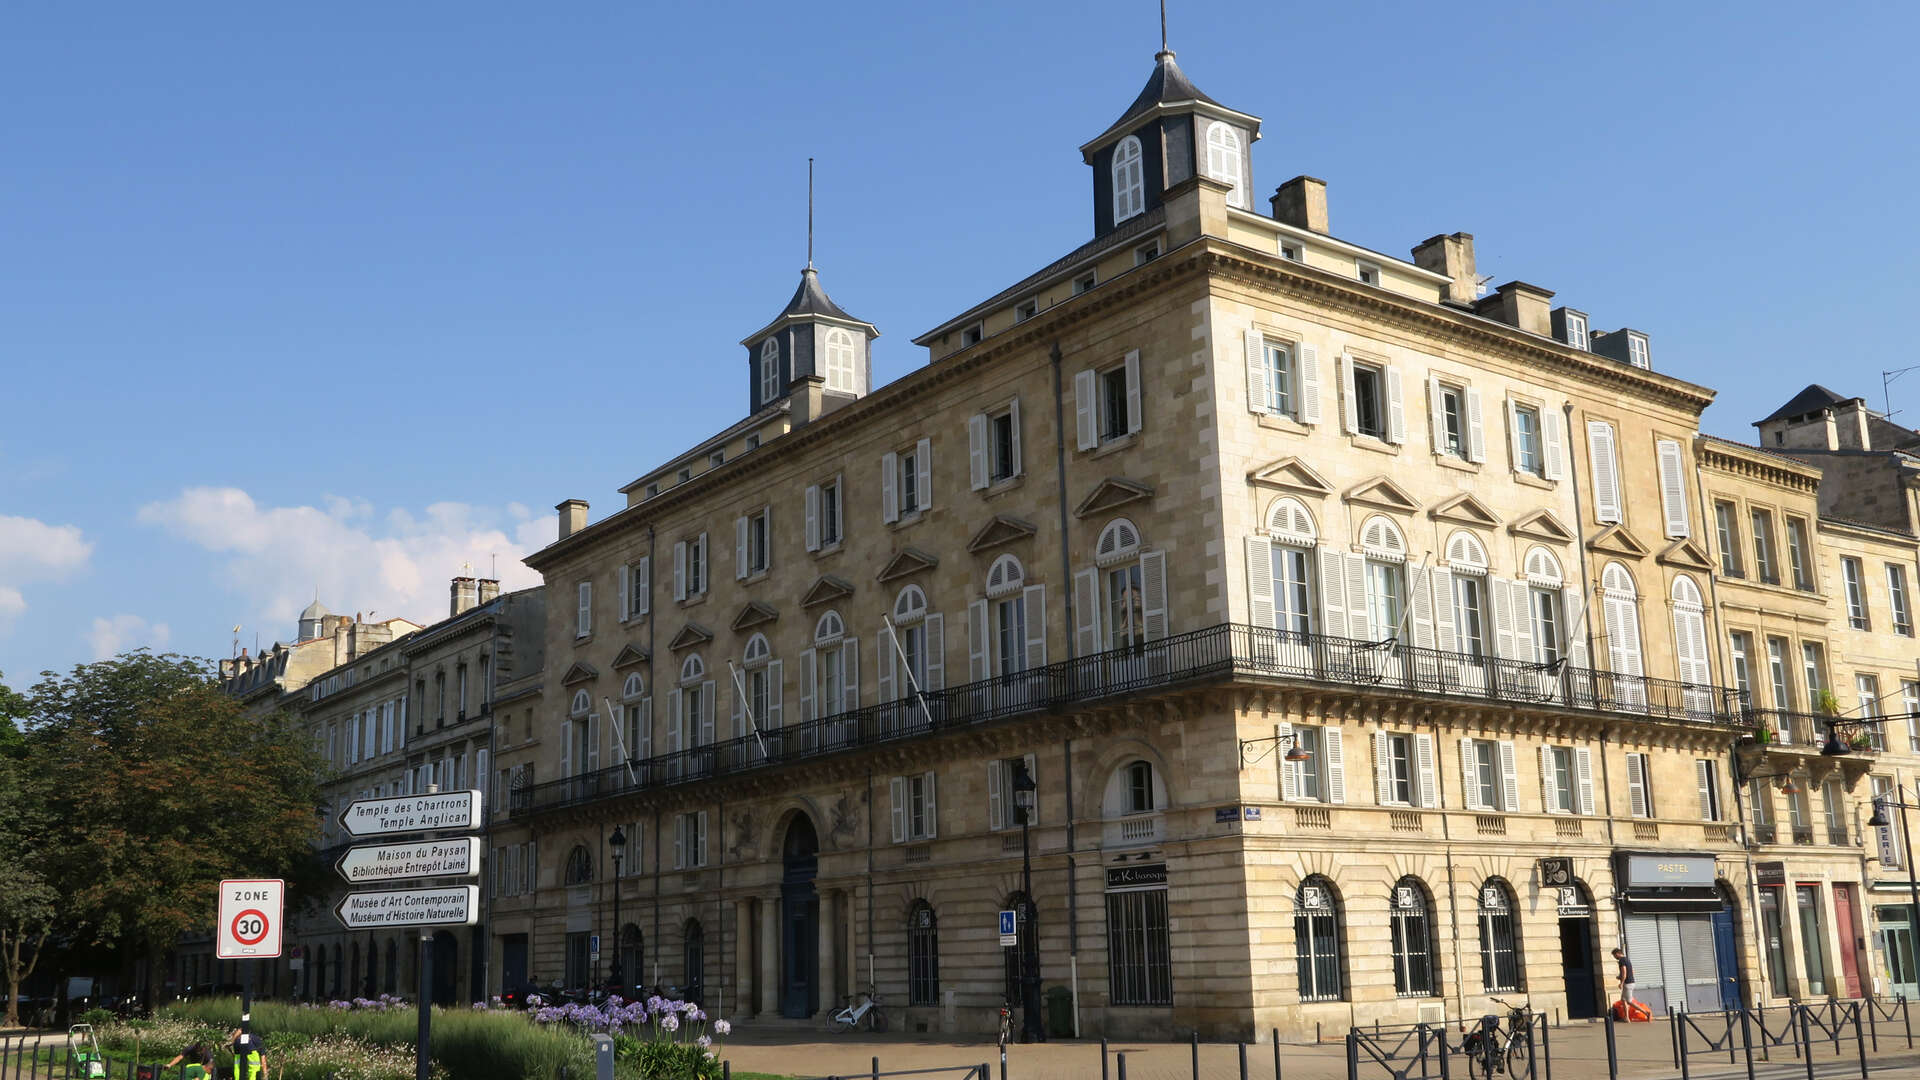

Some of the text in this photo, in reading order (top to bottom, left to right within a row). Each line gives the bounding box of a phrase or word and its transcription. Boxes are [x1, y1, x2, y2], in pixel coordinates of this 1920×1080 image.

[356, 799, 468, 817] Temple des Chartrons
[380, 812, 467, 829] Temple Anglican
[377, 846, 466, 862] Maison du Paysan
[352, 859, 466, 877] Bibliothèque Entrepôt Lainé
[1135, 871, 1166, 881] baroqu
[1657, 863, 1688, 873] PASTEL
[235, 891, 268, 901] ZONE
[351, 892, 464, 909] Musée d'Art Contemporain
[350, 907, 464, 923] Muséum d'Histoire Naturelle
[240, 920, 262, 935] 30
